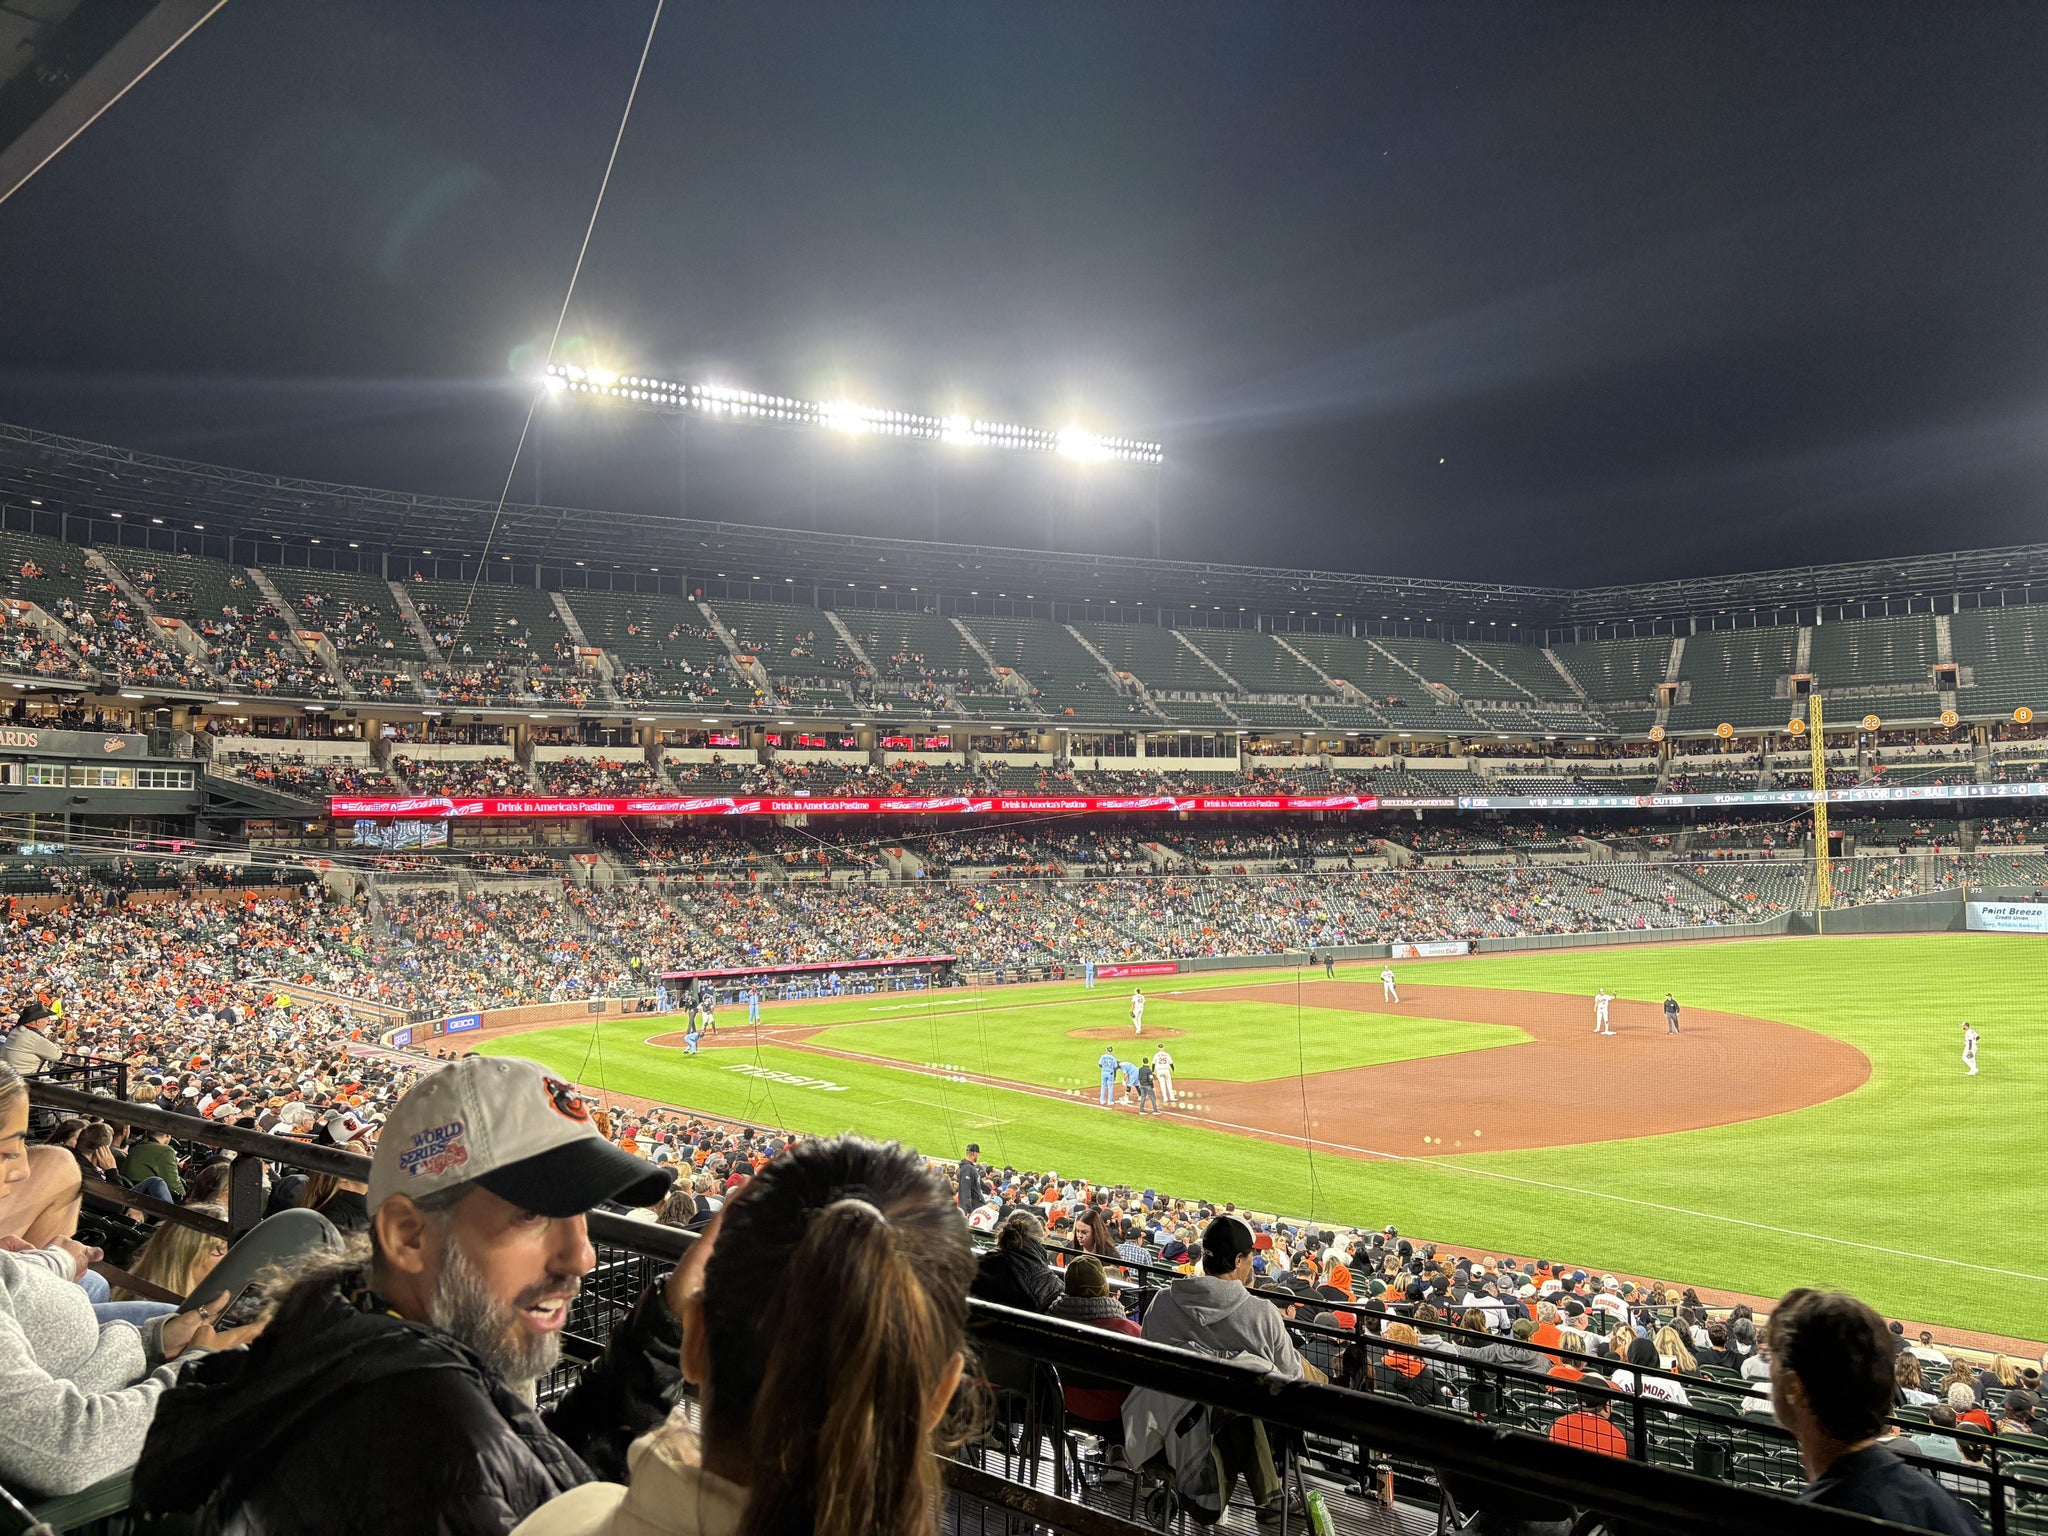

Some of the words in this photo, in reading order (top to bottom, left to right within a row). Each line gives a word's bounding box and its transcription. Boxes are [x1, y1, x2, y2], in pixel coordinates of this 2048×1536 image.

[1944, 715, 1956, 723] 33
[2020, 711, 2026, 719] 8
[1792, 722, 1798, 730] 4
[1866, 718, 1877, 727] 22
[1651, 730, 1663, 738] 20
[1722, 726, 1728, 735] 5
[1866, 790, 1888, 799] TOR
[1924, 788, 1945, 796] BAL
[1954, 788, 1962, 796] 4
[1002, 801, 1020, 809] Drink
[1028, 801, 1060, 809] America's
[1061, 801, 1087, 809] Pastime
[1653, 797, 1683, 805] CUTTER
[497, 802, 522, 812] Drink
[524, 802, 532, 812] in
[536, 802, 578, 812] America's
[579, 802, 614, 812] Pastime
[772, 802, 793, 811] Drink
[794, 802, 801, 811] in
[803, 802, 839, 811] America's
[840, 802, 869, 811] Pastime
[2009, 908, 2042, 916] Breeze
[450, 1018, 474, 1029] GEICO
[1158, 1057, 1167, 1065] 25
[414, 1123, 462, 1147] WORLD
[400, 1140, 446, 1169] SERIES
[1624, 1383, 1672, 1402] ALMORE
